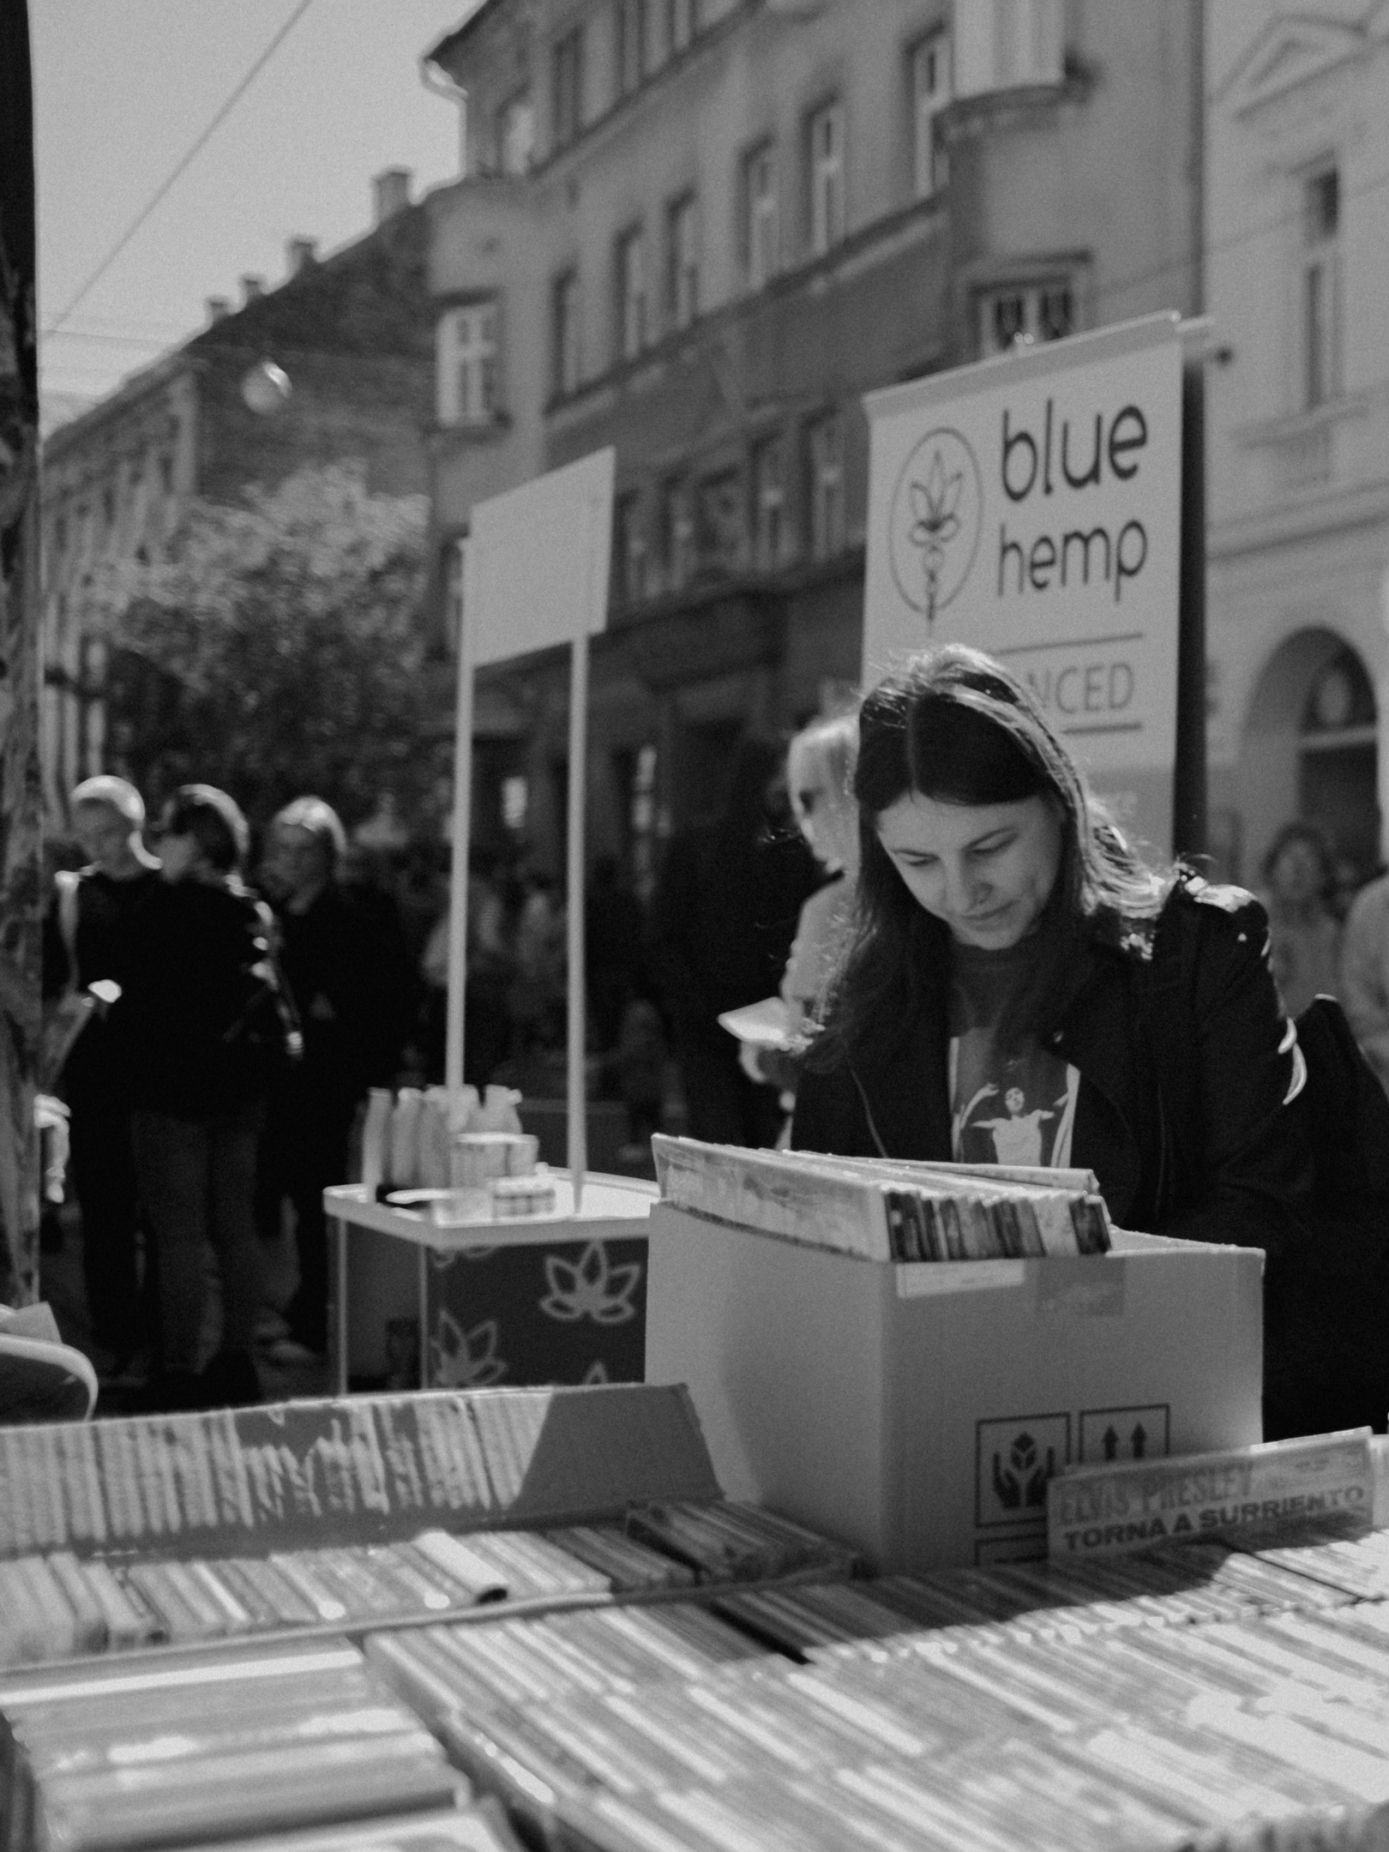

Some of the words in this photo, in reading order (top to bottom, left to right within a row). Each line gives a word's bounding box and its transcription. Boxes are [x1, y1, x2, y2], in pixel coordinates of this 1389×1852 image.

[1001, 398, 1149, 503] blue
[997, 519, 1149, 603] hemp
[1060, 1479, 1130, 1526] ELVIS
[1140, 1462, 1254, 1515] PRESLEY
[1064, 1517, 1168, 1551] TORNA
[1173, 1513, 1194, 1534] A
[1199, 1485, 1365, 1530] SURRIENTO
